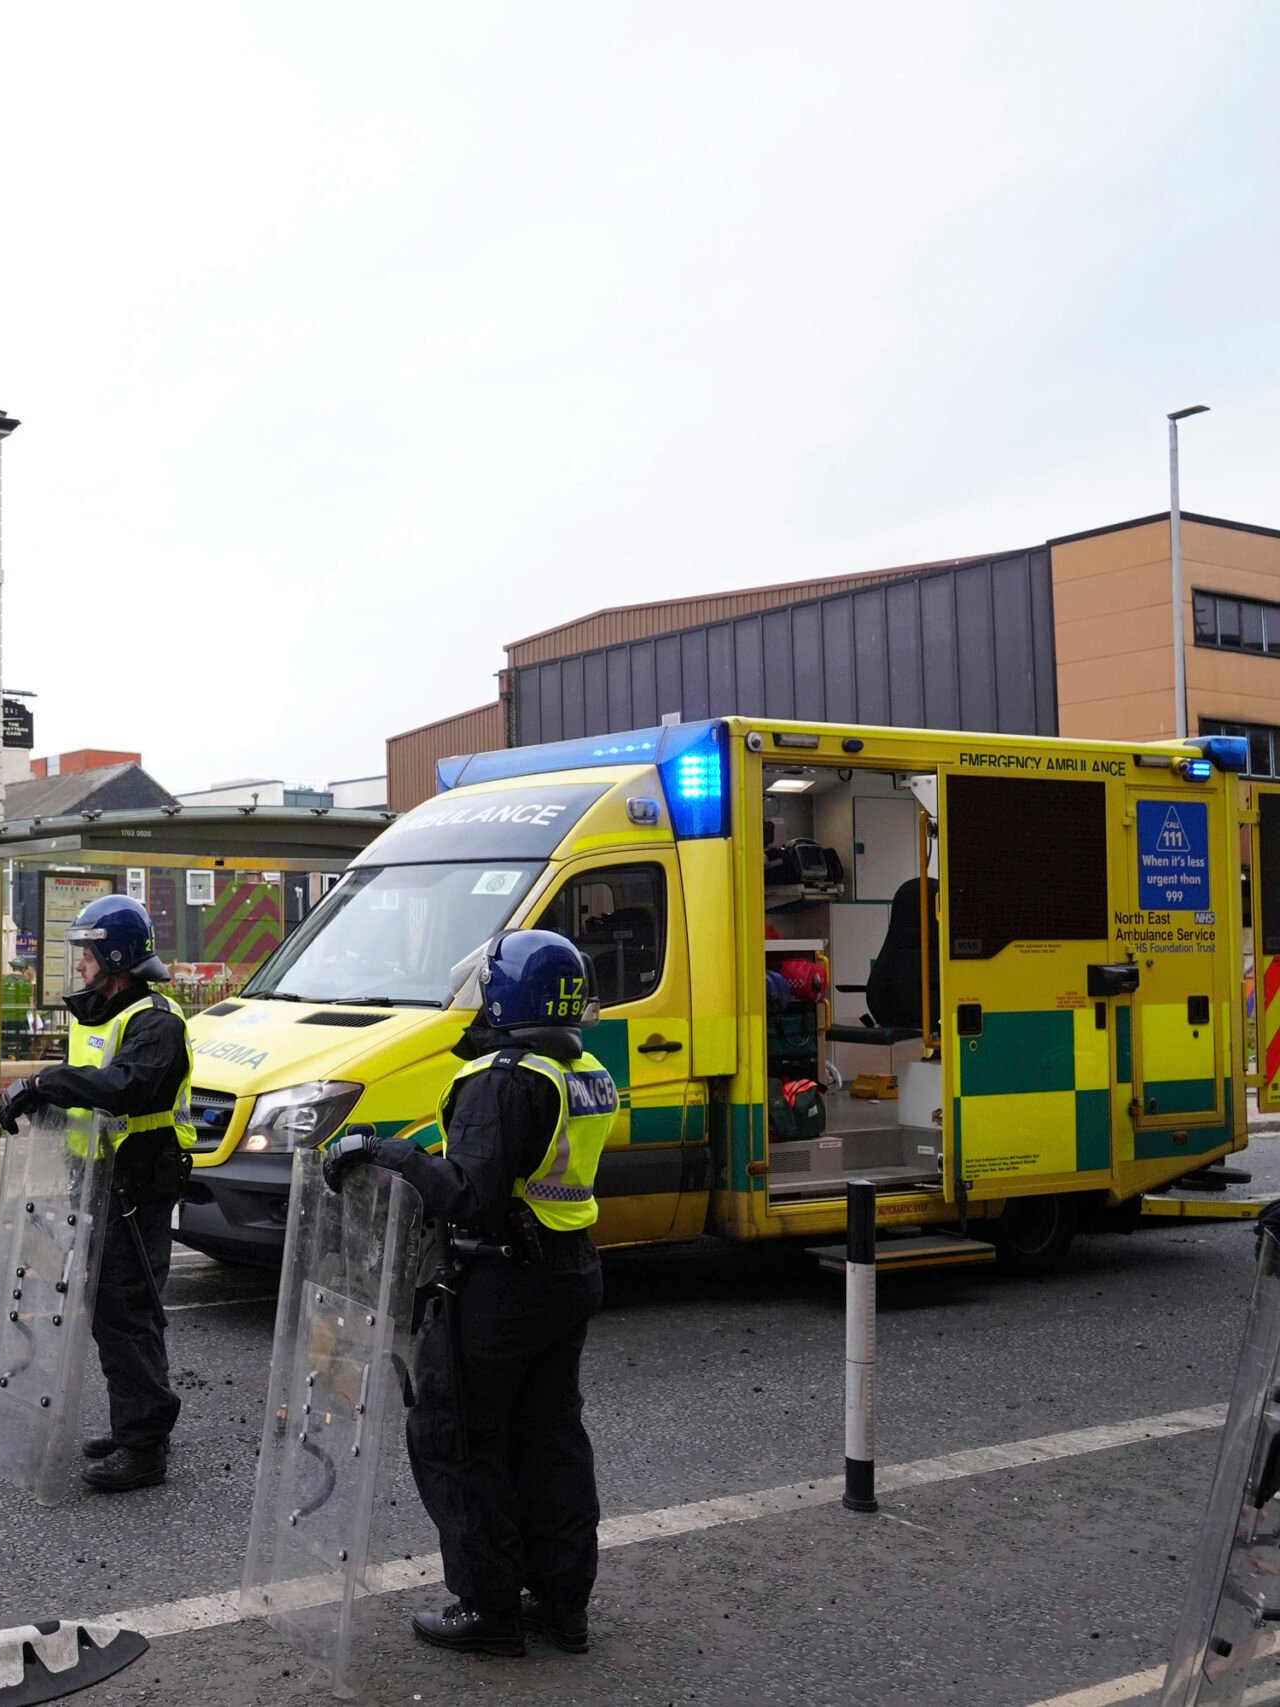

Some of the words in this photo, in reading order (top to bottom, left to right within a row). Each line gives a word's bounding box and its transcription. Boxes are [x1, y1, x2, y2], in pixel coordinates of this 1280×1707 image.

[1166, 821, 1180, 829] CALL
[1163, 831, 1183, 846] 111
[1142, 855, 1169, 867] When
[1171, 855, 1185, 867] it's
[1187, 856, 1205, 868] less
[1147, 875, 1178, 887] urgent
[1180, 873, 1201, 885] than
[1166, 891, 1184, 902] 999
[1114, 912, 1144, 924] North
[1148, 912, 1171, 924] East
[1195, 912, 1215, 924] NHS
[1116, 928, 1173, 941] Ambulance
[1177, 928, 1215, 941] Service
[1134, 943, 1148, 953] HS
[1150, 943, 1193, 953] Foundation
[1197, 942, 1216, 952] Trust
[560, 978, 584, 999] LZ
[546, 1000, 587, 1016] 1892
[568, 1077, 613, 1108] POLICE
